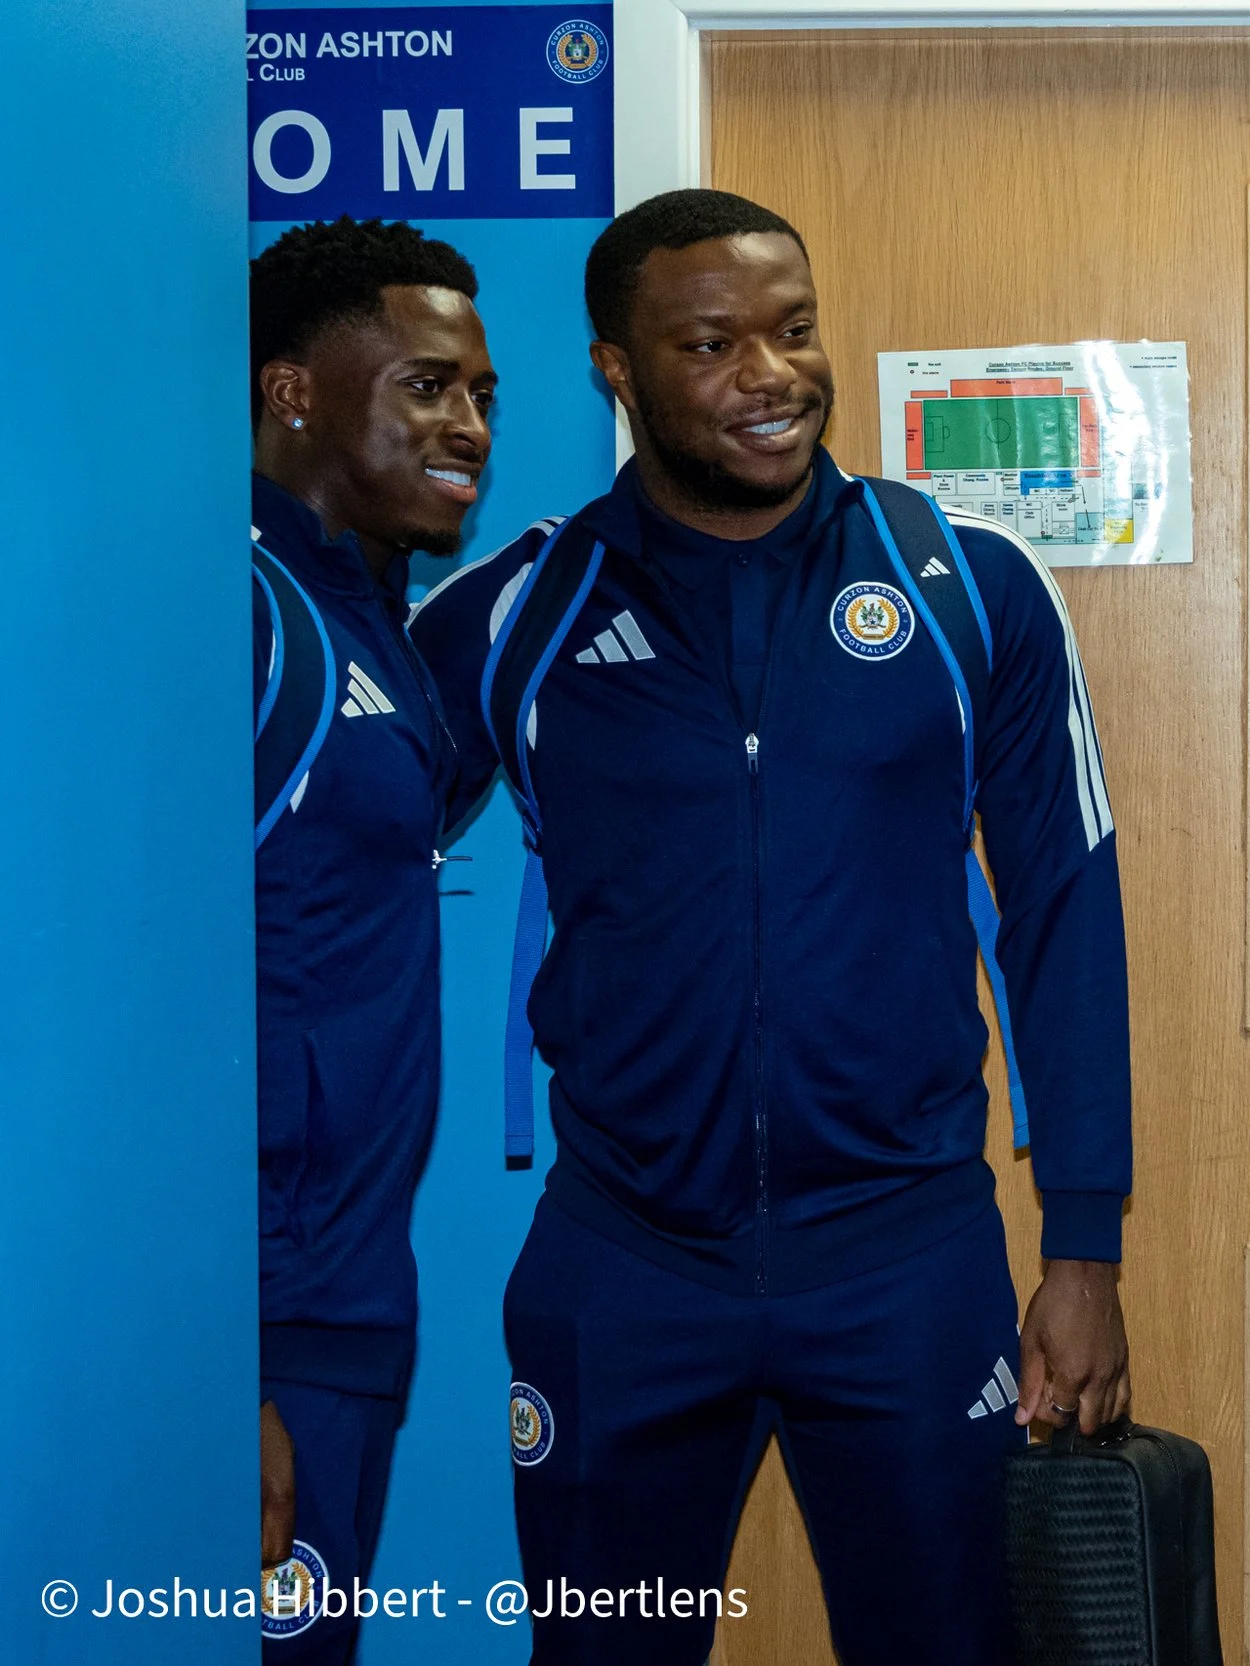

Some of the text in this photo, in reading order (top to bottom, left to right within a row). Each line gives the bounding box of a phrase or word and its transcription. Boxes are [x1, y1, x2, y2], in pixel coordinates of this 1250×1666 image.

[316, 30, 453, 58] ASHTON
[837, 586, 908, 614] CURZON ASHTON
[839, 628, 907, 654] FOOTBALL CLUB
